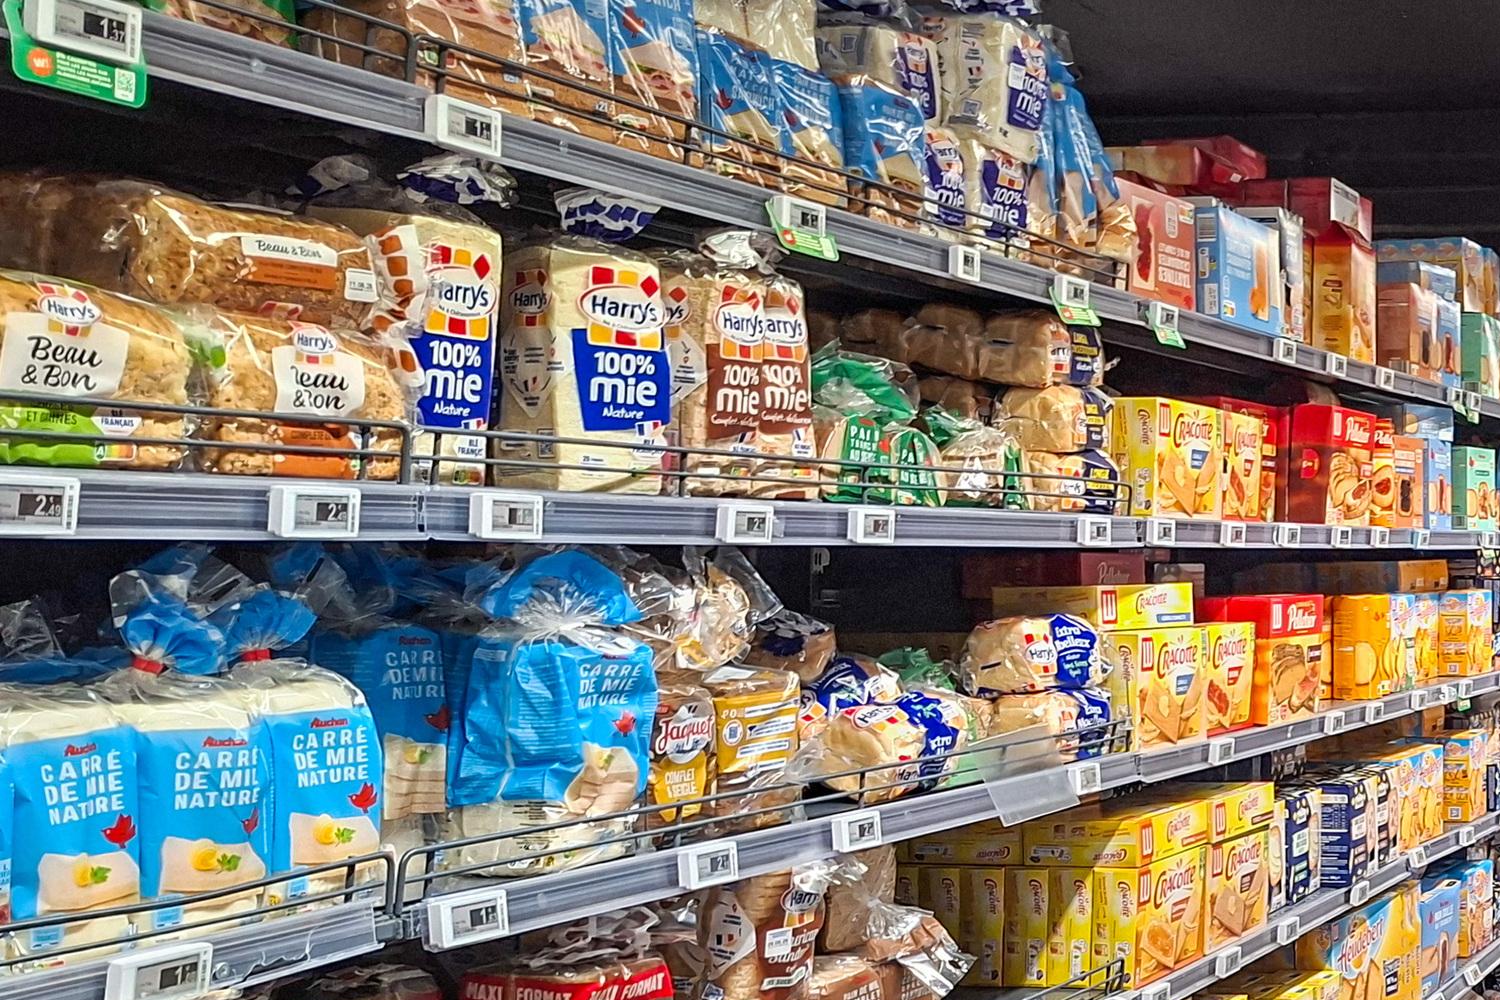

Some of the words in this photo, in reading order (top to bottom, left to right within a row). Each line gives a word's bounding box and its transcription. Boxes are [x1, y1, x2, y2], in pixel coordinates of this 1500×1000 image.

[1016, 92, 1043, 119] mie
[993, 187, 1022, 206] 100%
[256, 240, 289, 254] Beau
[300, 246, 322, 258] Bon
[434, 284, 489, 310] arrys
[47, 300, 96, 319] Harrys
[591, 295, 658, 323] Harrys
[721, 312, 764, 335] Harrys
[767, 318, 803, 337] arrys
[27, 336, 102, 366] Beau
[297, 333, 335, 350] Harrys
[429, 340, 481, 368] 100%
[594, 351, 656, 376] 100%
[21, 364, 38, 386] &
[44, 365, 96, 391] Bon
[425, 368, 483, 403] mie
[721, 364, 760, 386] 100%
[293, 390, 307, 408] &
[590, 376, 658, 407] mie
[716, 388, 760, 415] mie
[764, 388, 809, 412] mie
[432, 401, 471, 417] Nature
[602, 405, 645, 420] Nature
[100, 416, 135, 428] FRANÇAIS
[1030, 649, 1056, 662] Harrys
[579, 679, 598, 694] DE
[601, 678, 635, 693] MIE
[577, 692, 629, 709] NATURE
[310, 717, 349, 729] Auchan
[292, 725, 368, 752] CARRÉ
[293, 751, 319, 770] DE
[326, 745, 369, 766] MIE
[175, 771, 209, 792] DE
[297, 764, 369, 789] NATURE
[664, 768, 695, 784] COMPLET
[44, 782, 79, 807] DE
[621, 973, 666, 1000] FORMAT
